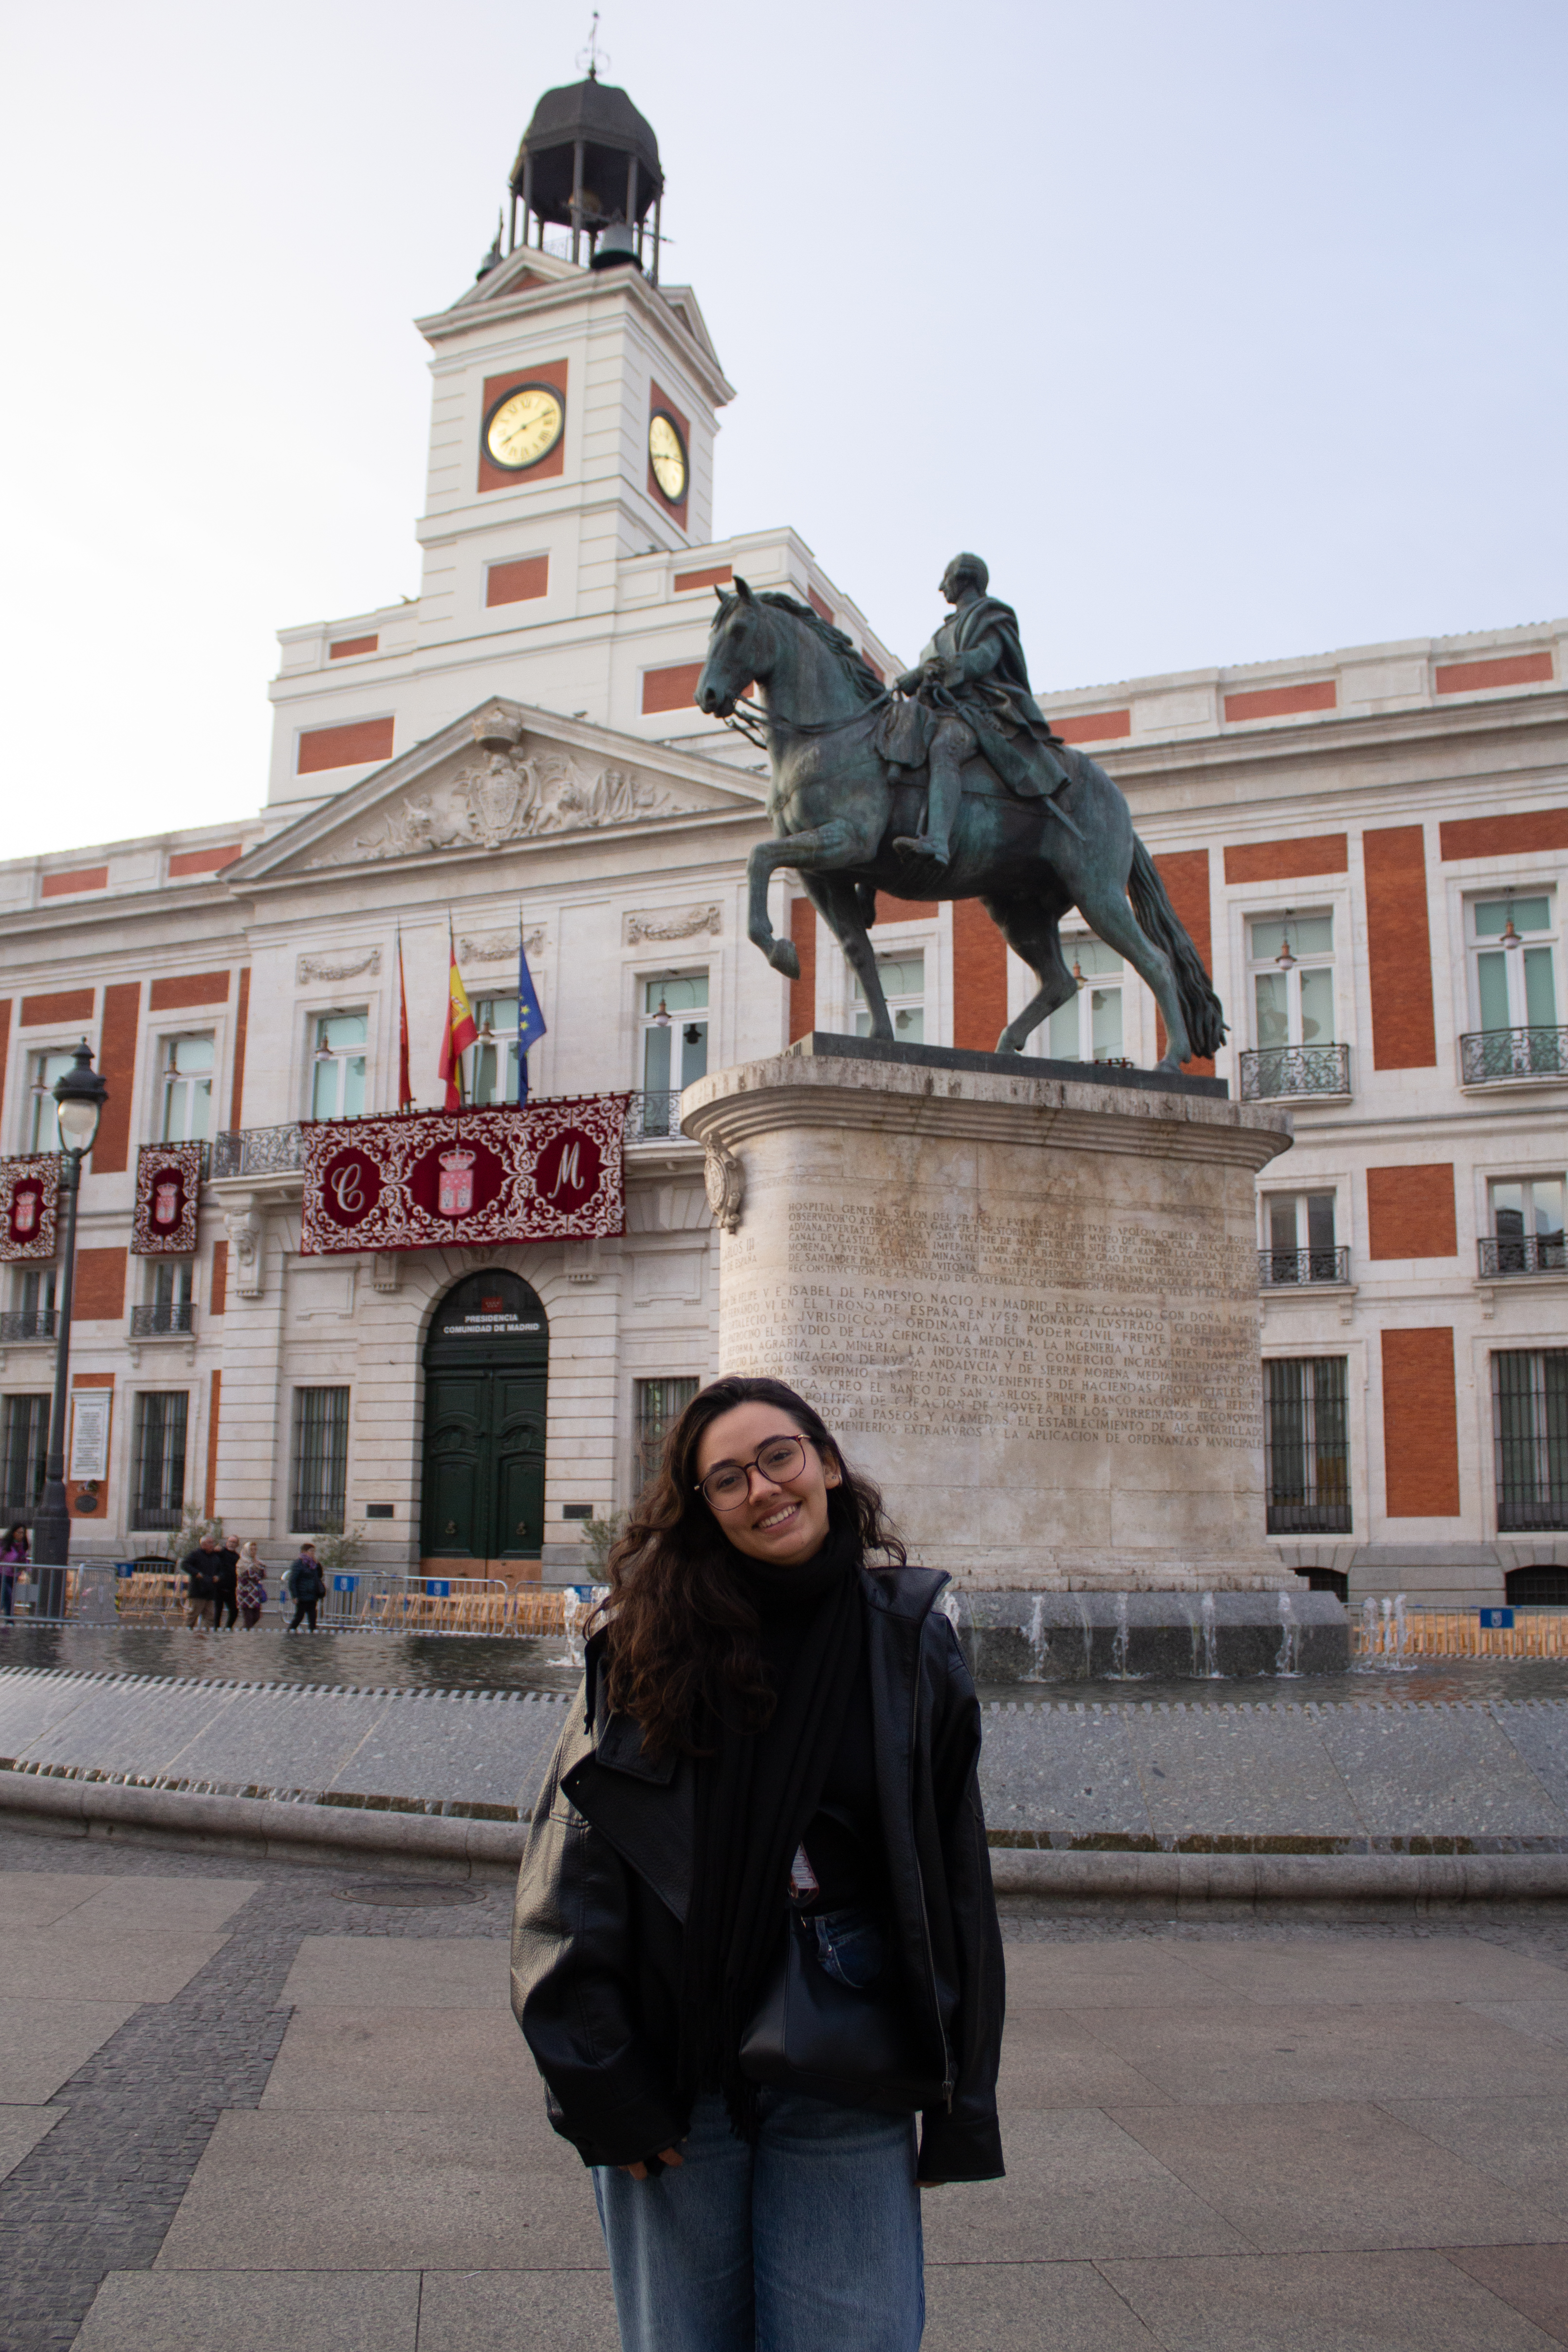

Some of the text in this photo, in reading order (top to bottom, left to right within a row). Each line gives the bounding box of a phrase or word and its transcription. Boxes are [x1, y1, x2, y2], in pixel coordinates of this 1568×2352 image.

[789, 1203, 835, 1213] HOSPITAL
[789, 1233, 815, 1242] CANAL
[821, 1233, 832, 1242] DE
[937, 1232, 954, 1241] SAN
[789, 1243, 826, 1252] MORENA
[842, 1245, 869, 1255] NVEVA
[932, 1252, 960, 1261] MINAS
[789, 1253, 799, 1262] DE
[922, 1261, 932, 1270] DE
[880, 1268, 891, 1277] DE
[914, 1271, 950, 1281] CIVDAD
[763, 1287, 769, 1298] V
[776, 1286, 781, 1296] E
[790, 1285, 831, 1296] ISABEL
[841, 1286, 855, 1298] DE
[864, 1288, 926, 1303] FARNESIO.
[931, 1293, 973, 1306] NACIO
[982, 1296, 996, 1308] EN
[1004, 1298, 1047, 1312] MADRID
[1056, 1302, 1069, 1314] EN
[1102, 1306, 1152, 1318] CASADO
[1161, 1310, 1184, 1320] CON
[1191, 1312, 1220, 1323] DOÑA
[765, 1300, 775, 1312] VI
[781, 1298, 793, 1310] EN
[804, 1298, 817, 1309] EL
[830, 1299, 874, 1312] TRONO
[884, 1302, 900, 1314] DE
[910, 1305, 959, 1318] ESPAÑA
[969, 1309, 983, 1320] EN
[1030, 1314, 1090, 1327] MONARCA
[1098, 1318, 1163, 1332] ILVSTRADO
[443, 1325, 492, 1333] COMUNIDAD
[507, 1323, 540, 1331] MADRID
[464, 1314, 518, 1323] PRESIDENCIA
[774, 1312, 788, 1324] LA
[906, 1317, 979, 1332] ORDINARIA
[989, 1323, 996, 1333] Y
[1004, 1324, 1016, 1335] EL
[1027, 1326, 1070, 1338] PODER
[1080, 1330, 1113, 1341] CIVIL
[1122, 1332, 1165, 1345] FRENTE
[1174, 1335, 1181, 1345] A
[765, 1327, 775, 1337] EL
[781, 1325, 830, 1336] ESTVDIO
[840, 1326, 854, 1337] DE
[862, 1328, 884, 1339] LAS
[957, 1334, 971, 1345] LA
[1043, 1339, 1057, 1351] LA
[1066, 1341, 1121, 1354] INGENIERIA
[1128, 1345, 1135, 1355] Y
[1142, 1346, 1161, 1356] LAS
[1169, 1348, 1198, 1359] ARTES
[821, 1339, 837, 1350] LA
[847, 1340, 897, 1354] MINERIA
[909, 1344, 924, 1356] LA
[934, 1346, 999, 1359] INDVSTRIA
[1008, 1351, 1015, 1361] Y
[1024, 1352, 1036, 1362] EL
[764, 1352, 852, 1363] COLONIZACION
[860, 1354, 875, 1365] DE
[930, 1359, 997, 1372] ANDALVCIA
[1004, 1363, 1011, 1373] Y
[1019, 1364, 1033, 1375] DE
[1041, 1366, 1076, 1376] SIERRA
[1085, 1369, 1129, 1380] MORENA
[1137, 1372, 1188, 1383] MEDIANTE
[812, 1365, 868, 1378] SVPRIMIO
[912, 1371, 956, 1383] RENTAS
[964, 1374, 1051, 1389] PROVENIENTES
[1059, 1379, 1074, 1390] DE
[806, 1392, 863, 1405] POLITICA
[871, 1395, 886, 1406] DE
[973, 1401, 988, 1411] DE
[1062, 1406, 1076, 1415] EN
[1084, 1407, 1108, 1417] LOS
[830, 1380, 861, 1391] CREO
[870, 1382, 882, 1392] EL
[891, 1383, 930, 1395] BANCO
[938, 1386, 952, 1396] DE
[960, 1387, 981, 1398] SAN
[1047, 1392, 1086, 1403] PRIMER
[1094, 1394, 1131, 1405] BANCO
[1139, 1396, 1192, 1408] NACIONAL
[1200, 1399, 1219, 1409] DEL
[850, 1408, 865, 1419] DE
[873, 1409, 919, 1421] PASEOS
[928, 1411, 934, 1422] Y
[1018, 1416, 1030, 1426] EL
[1039, 1417, 1144, 1431] ESTABLECIMIENTO
[1152, 1422, 1165, 1433] DE
[828, 1421, 896, 1434] EMENTERIOS
[904, 1425, 982, 1437] EXTRAMVROS
[990, 1428, 996, 1438] Y
[1004, 1429, 1018, 1439] LA
[1028, 1430, 1098, 1442] APLICACION
[1106, 1434, 1120, 1444] DE
[1127, 1434, 1199, 1446] ORDENANZAS
